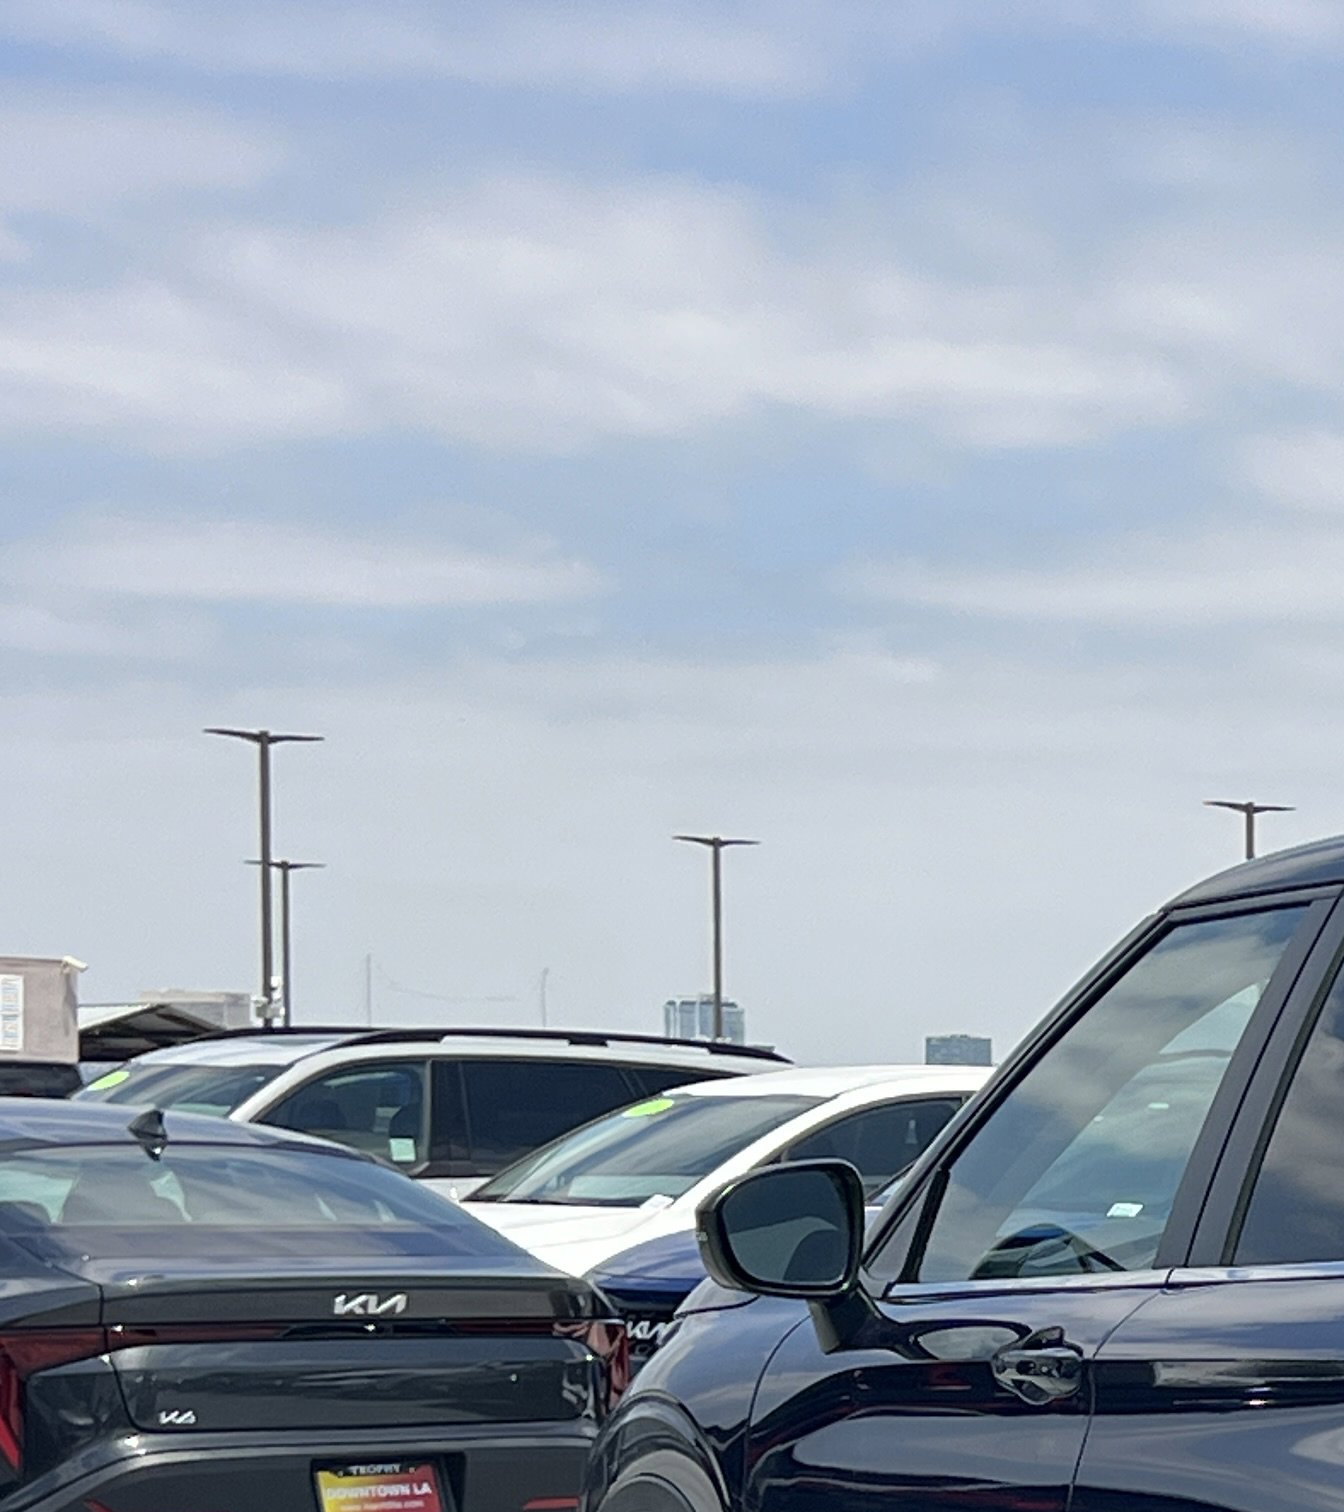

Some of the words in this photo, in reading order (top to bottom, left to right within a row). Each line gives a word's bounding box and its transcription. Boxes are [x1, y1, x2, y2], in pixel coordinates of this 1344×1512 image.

[333, 1293, 407, 1315] KIA
[326, 1484, 411, 1498] DOWNTOWN
[412, 1482, 433, 1496] LA
